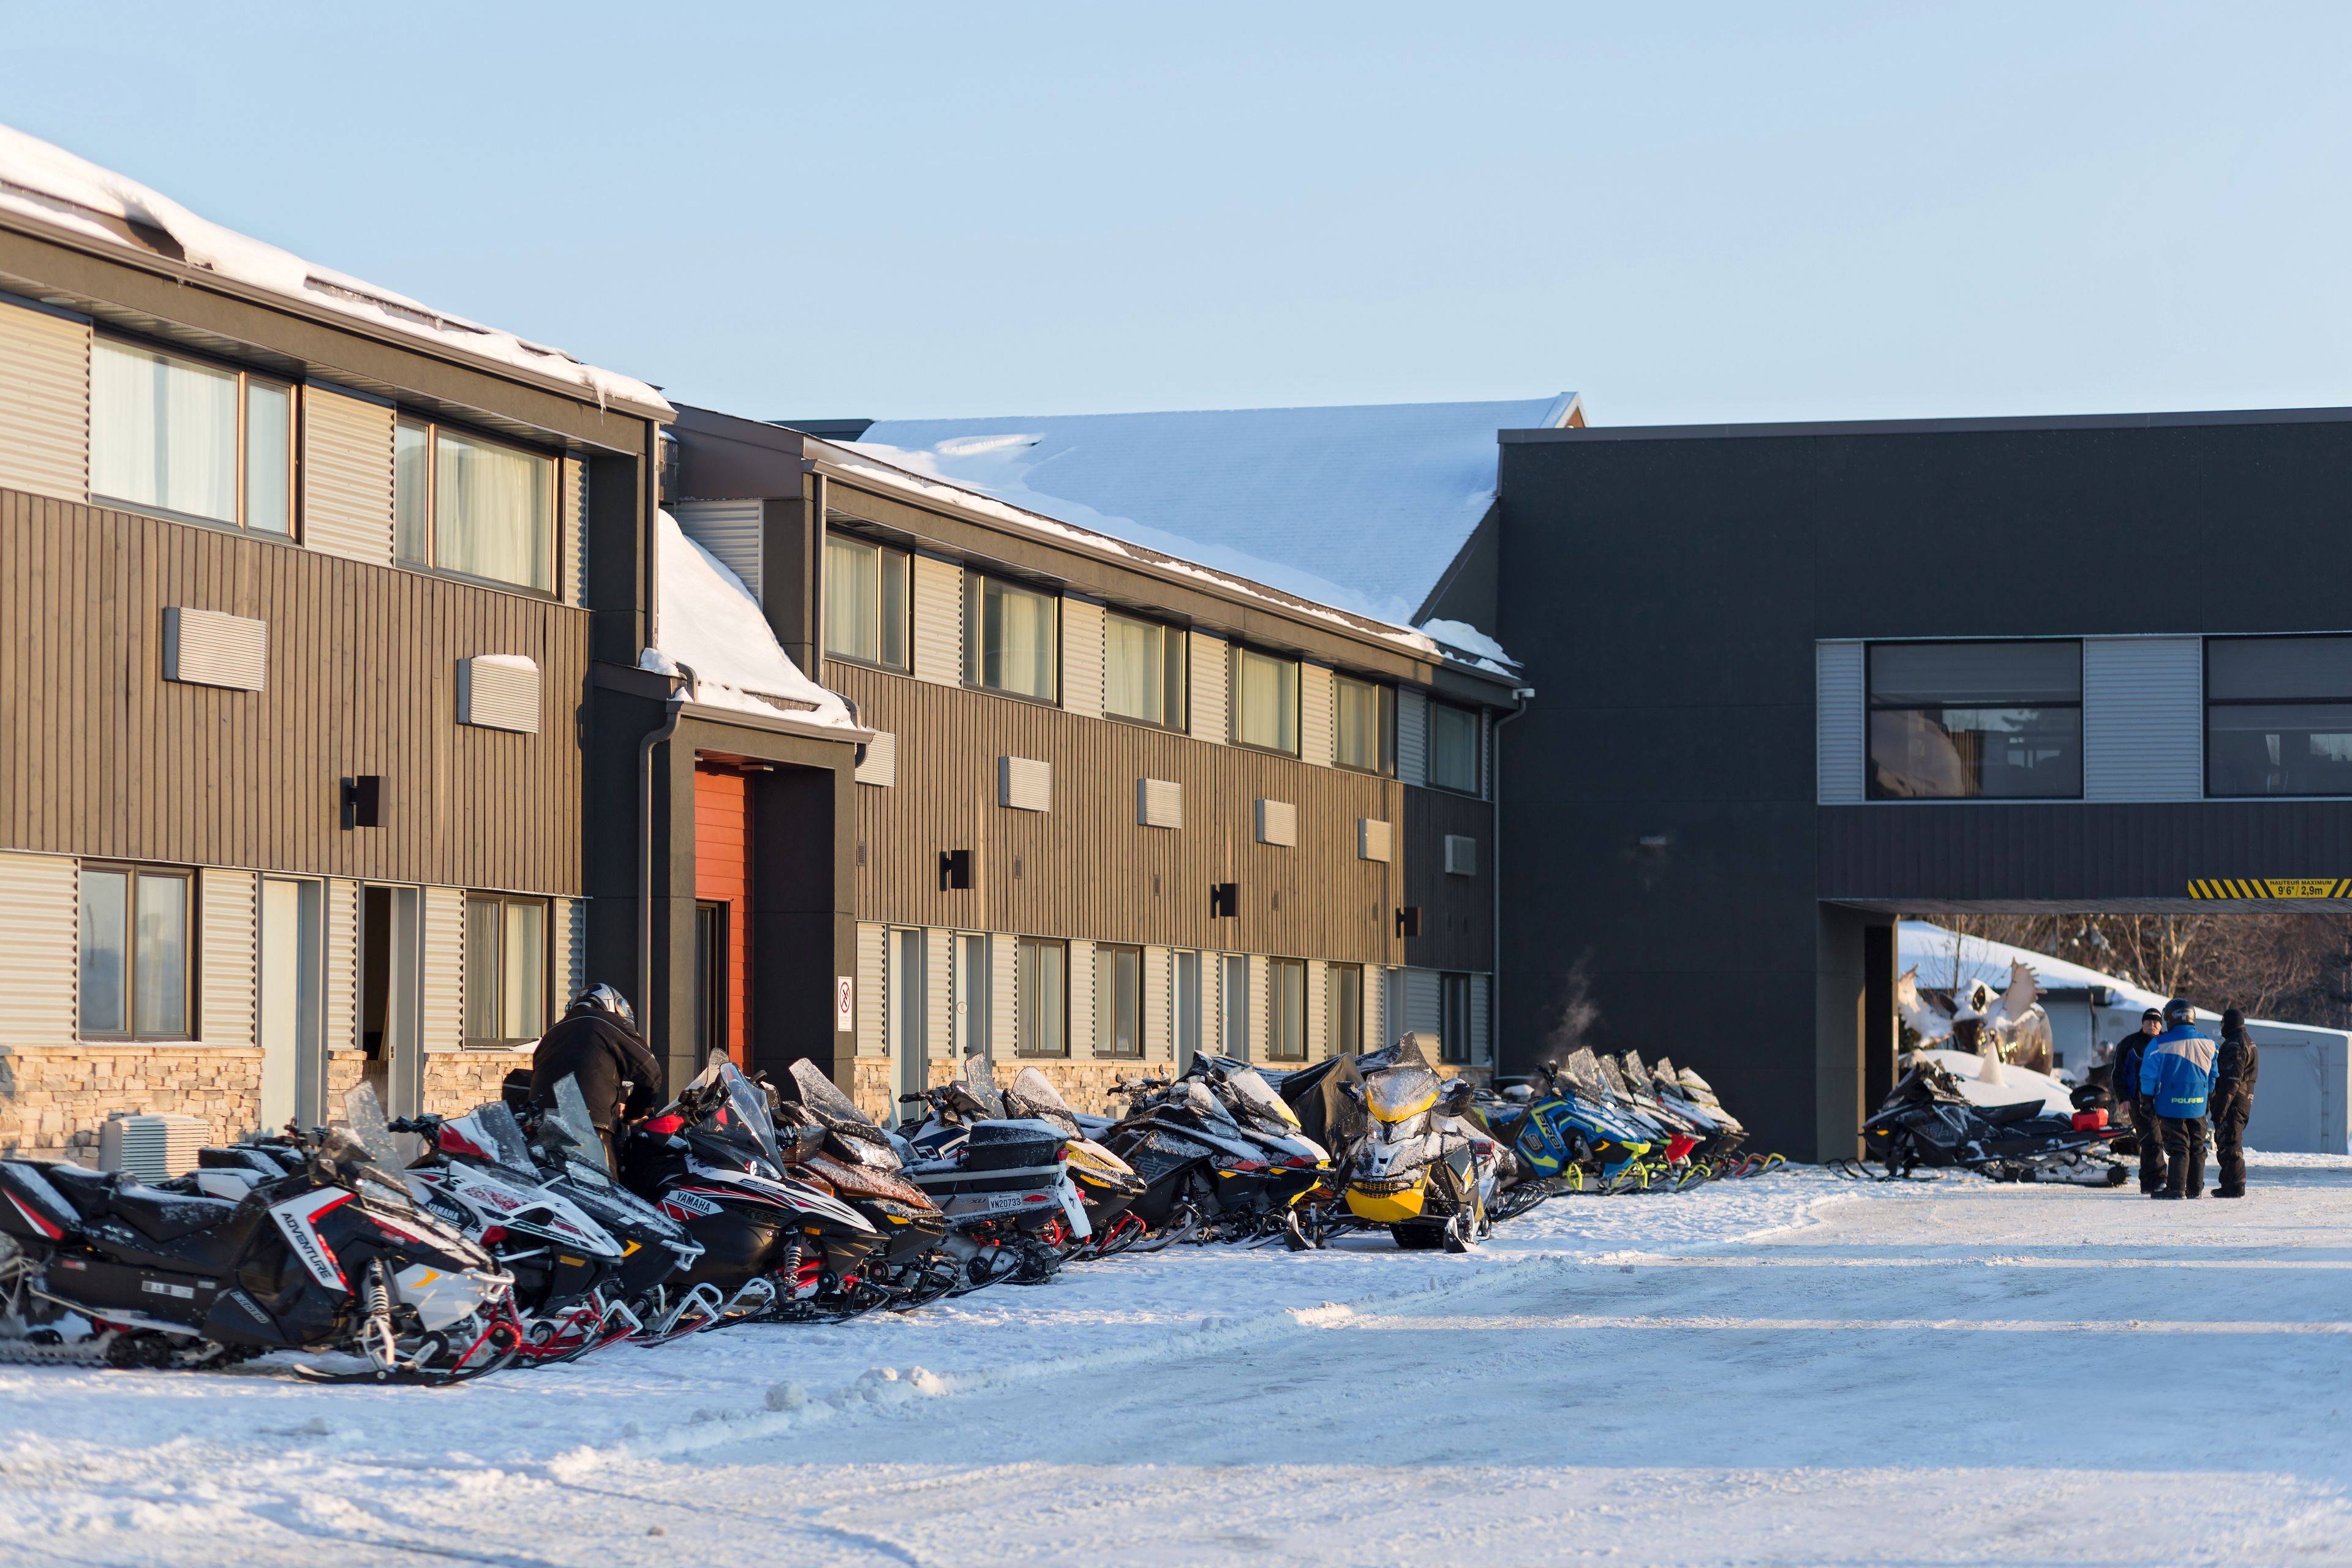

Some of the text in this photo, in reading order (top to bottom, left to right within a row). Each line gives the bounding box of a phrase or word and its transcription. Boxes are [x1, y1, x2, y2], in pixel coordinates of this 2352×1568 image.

[2301, 886, 2323, 897] 2,9m
[1535, 1112, 1562, 1149] PRO
[428, 1202, 459, 1221] YAMAHA
[569, 1194, 603, 1211] SWITCHBACK
[676, 1191, 710, 1213] YAMAHA
[990, 1197, 1022, 1209] VN20733
[281, 1213, 333, 1279] ADVENTURE
